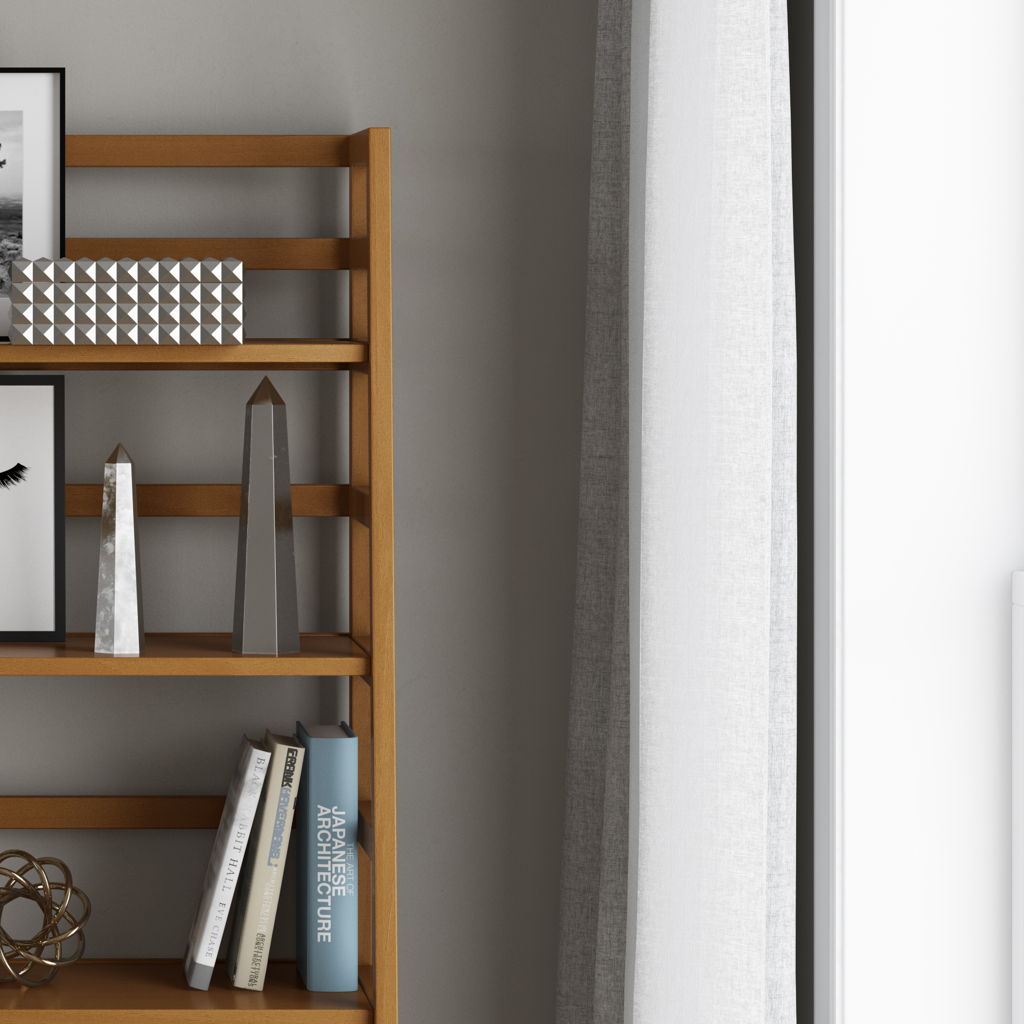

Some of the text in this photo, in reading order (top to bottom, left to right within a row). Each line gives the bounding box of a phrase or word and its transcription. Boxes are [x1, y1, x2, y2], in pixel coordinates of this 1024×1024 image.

[282, 748, 298, 788] FRANK
[332, 806, 346, 896] JAPANESE
[222, 858, 238, 892] HALL
[317, 804, 332, 942] ARCHITECTURE
[216, 902, 226, 921] EVE
